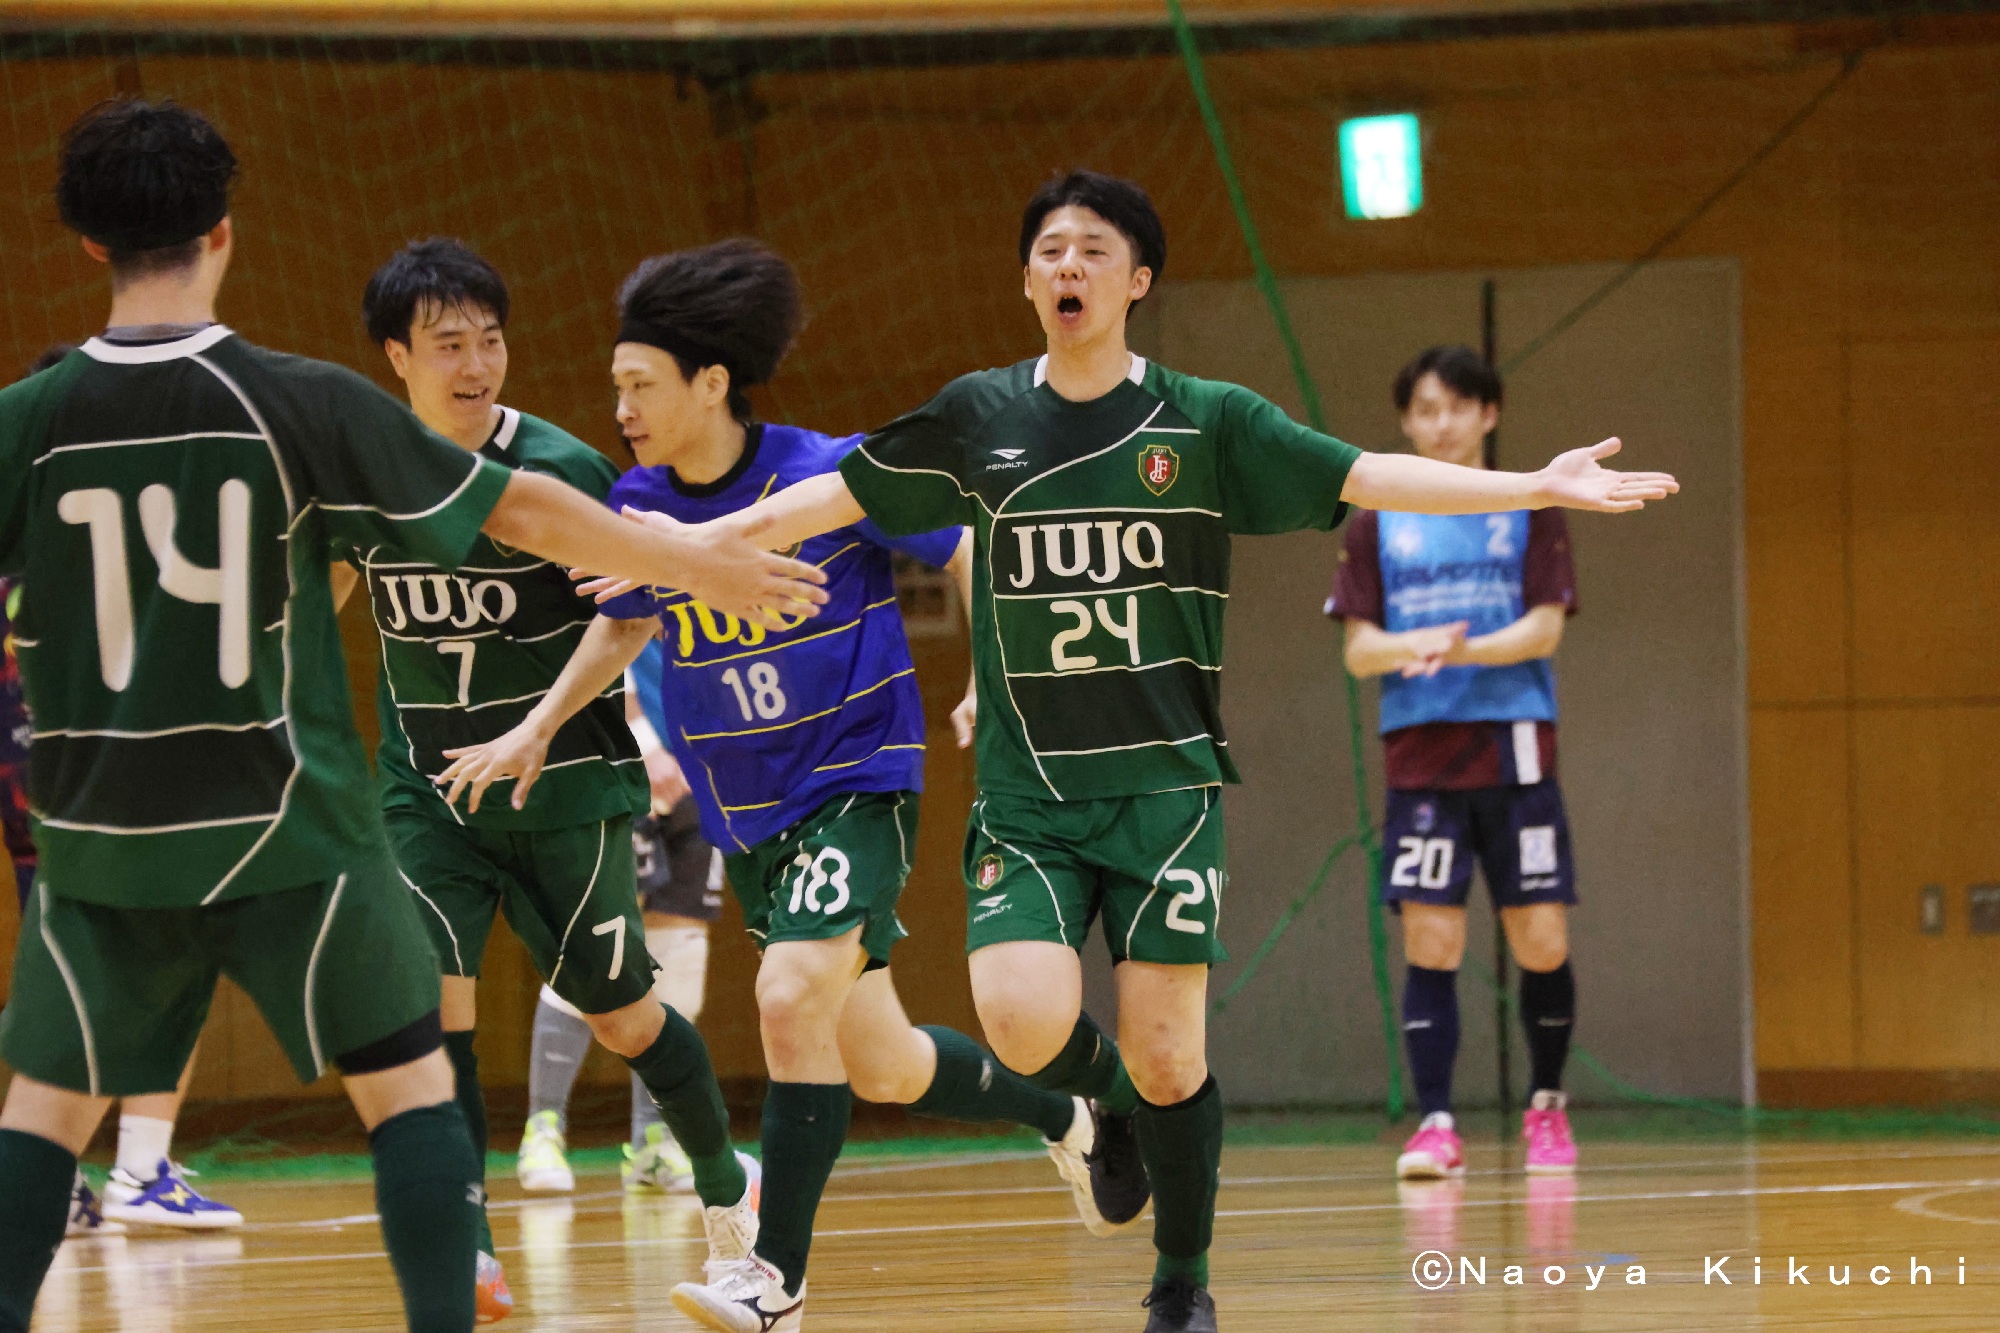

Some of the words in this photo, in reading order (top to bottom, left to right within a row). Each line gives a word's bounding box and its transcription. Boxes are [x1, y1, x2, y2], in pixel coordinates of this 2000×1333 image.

[985, 461, 1029, 471] PENALTY
[58, 478, 250, 692] 14
[1009, 520, 1163, 588] JUJO
[379, 574, 517, 628] JUJO
[1050, 595, 1141, 671] 24
[437, 641, 476, 705] 7
[721, 661, 787, 722] 18
[788, 846, 850, 915] 18
[1390, 837, 1453, 889] 20
[592, 915, 626, 980] 7
